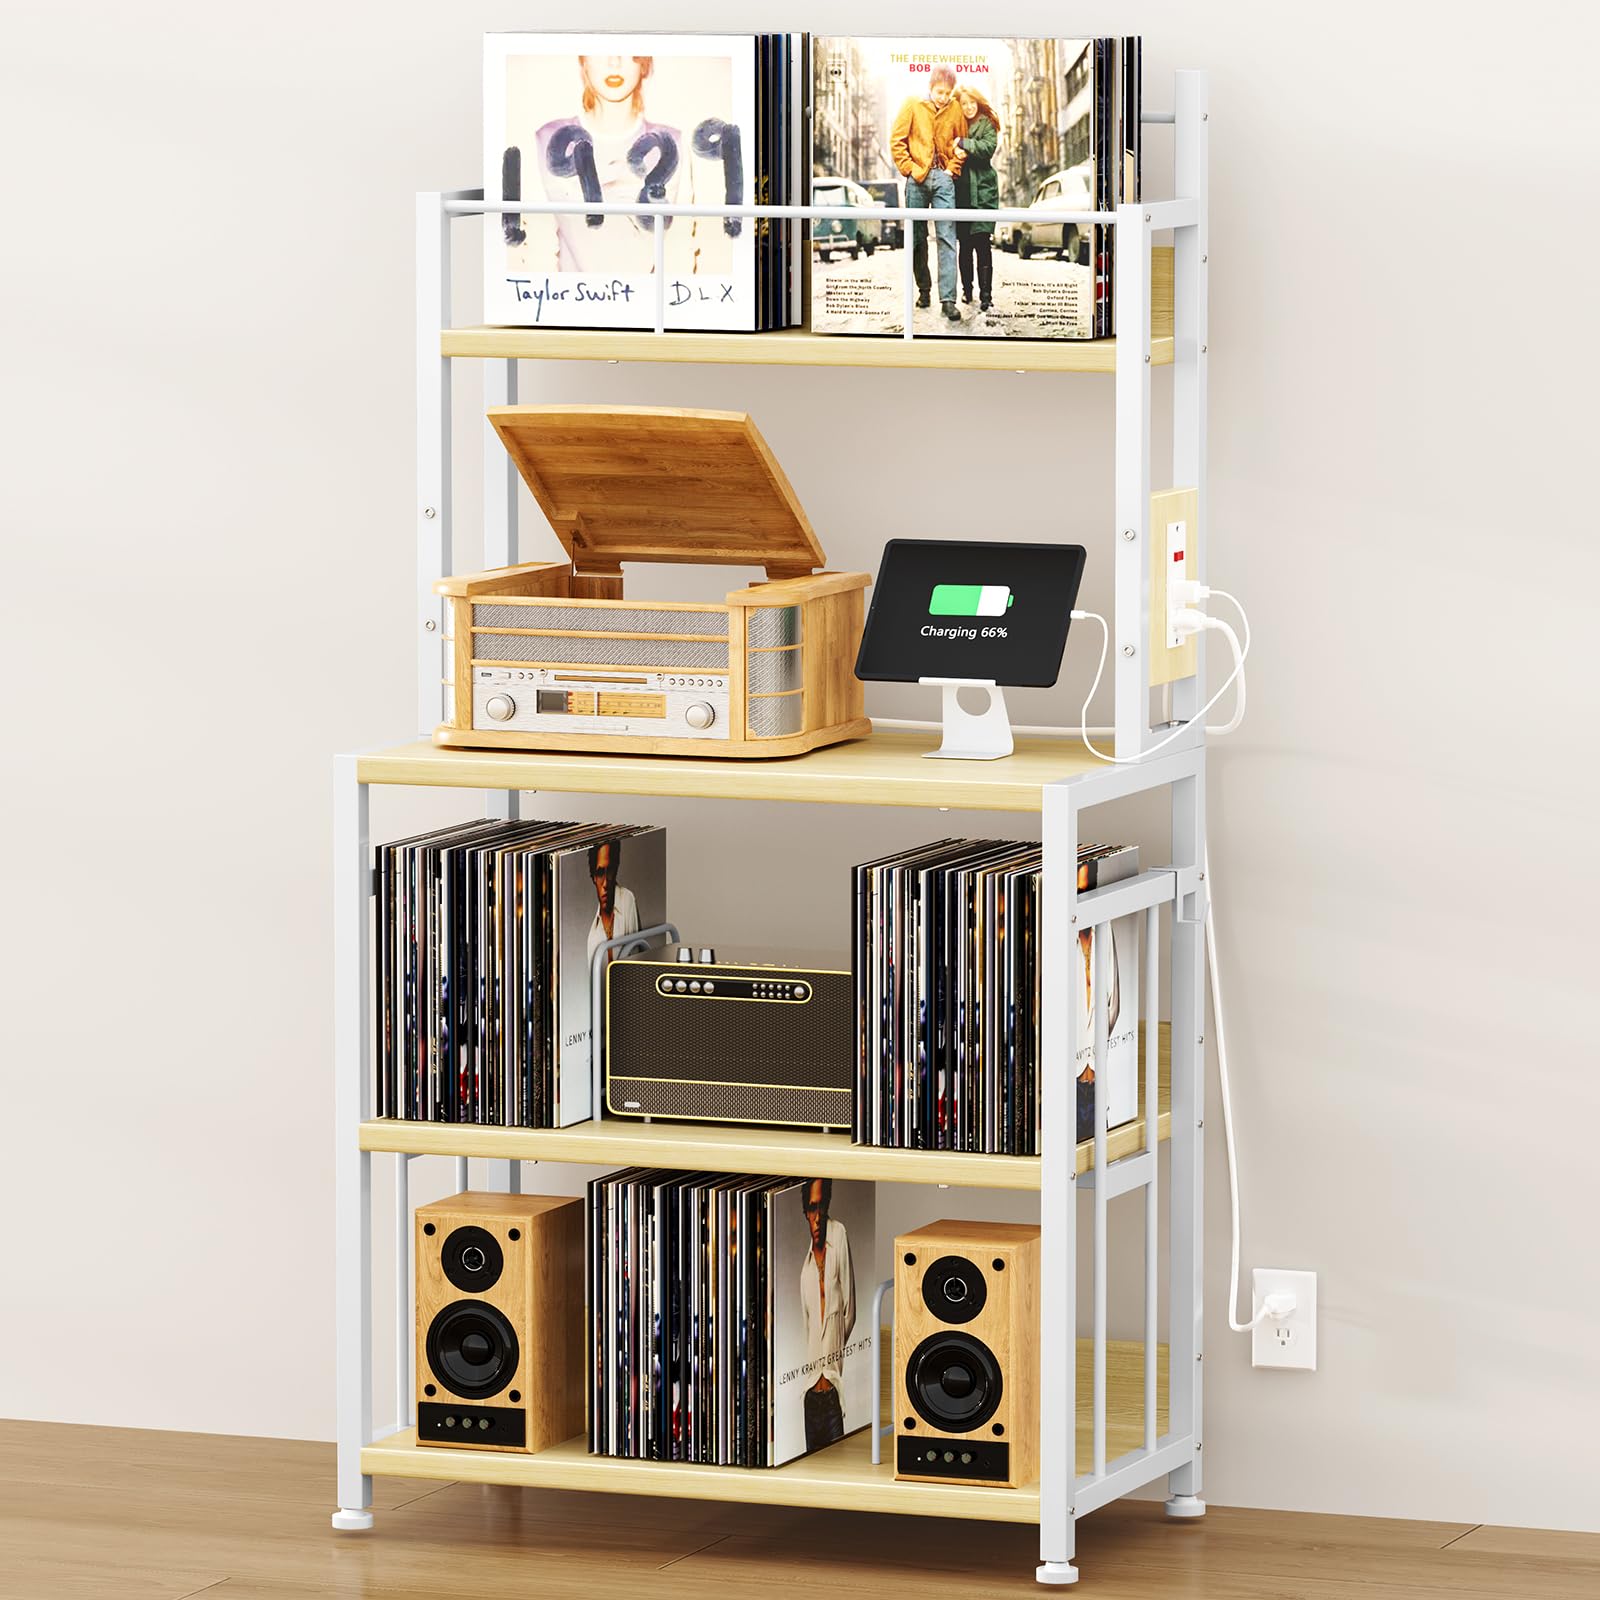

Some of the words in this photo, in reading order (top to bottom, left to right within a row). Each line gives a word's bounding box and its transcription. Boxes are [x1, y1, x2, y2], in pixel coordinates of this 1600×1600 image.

[890, 54, 909, 63] THE
[909, 63, 931, 73] BOB
[956, 64, 989, 73] DYLAN
[502, 117, 744, 247] 1989
[506, 278, 569, 322] Taylor
[575, 279, 635, 302] Swift
[920, 625, 977, 640] Charging
[981, 626, 1008, 638] 66%
[565, 1031, 587, 1047] LENNY
[779, 1367, 800, 1385] LENNY
[801, 1356, 826, 1376] KRAVITZ
[826, 1343, 857, 1365] GREATEST
[858, 1336, 872, 1351] HITS
